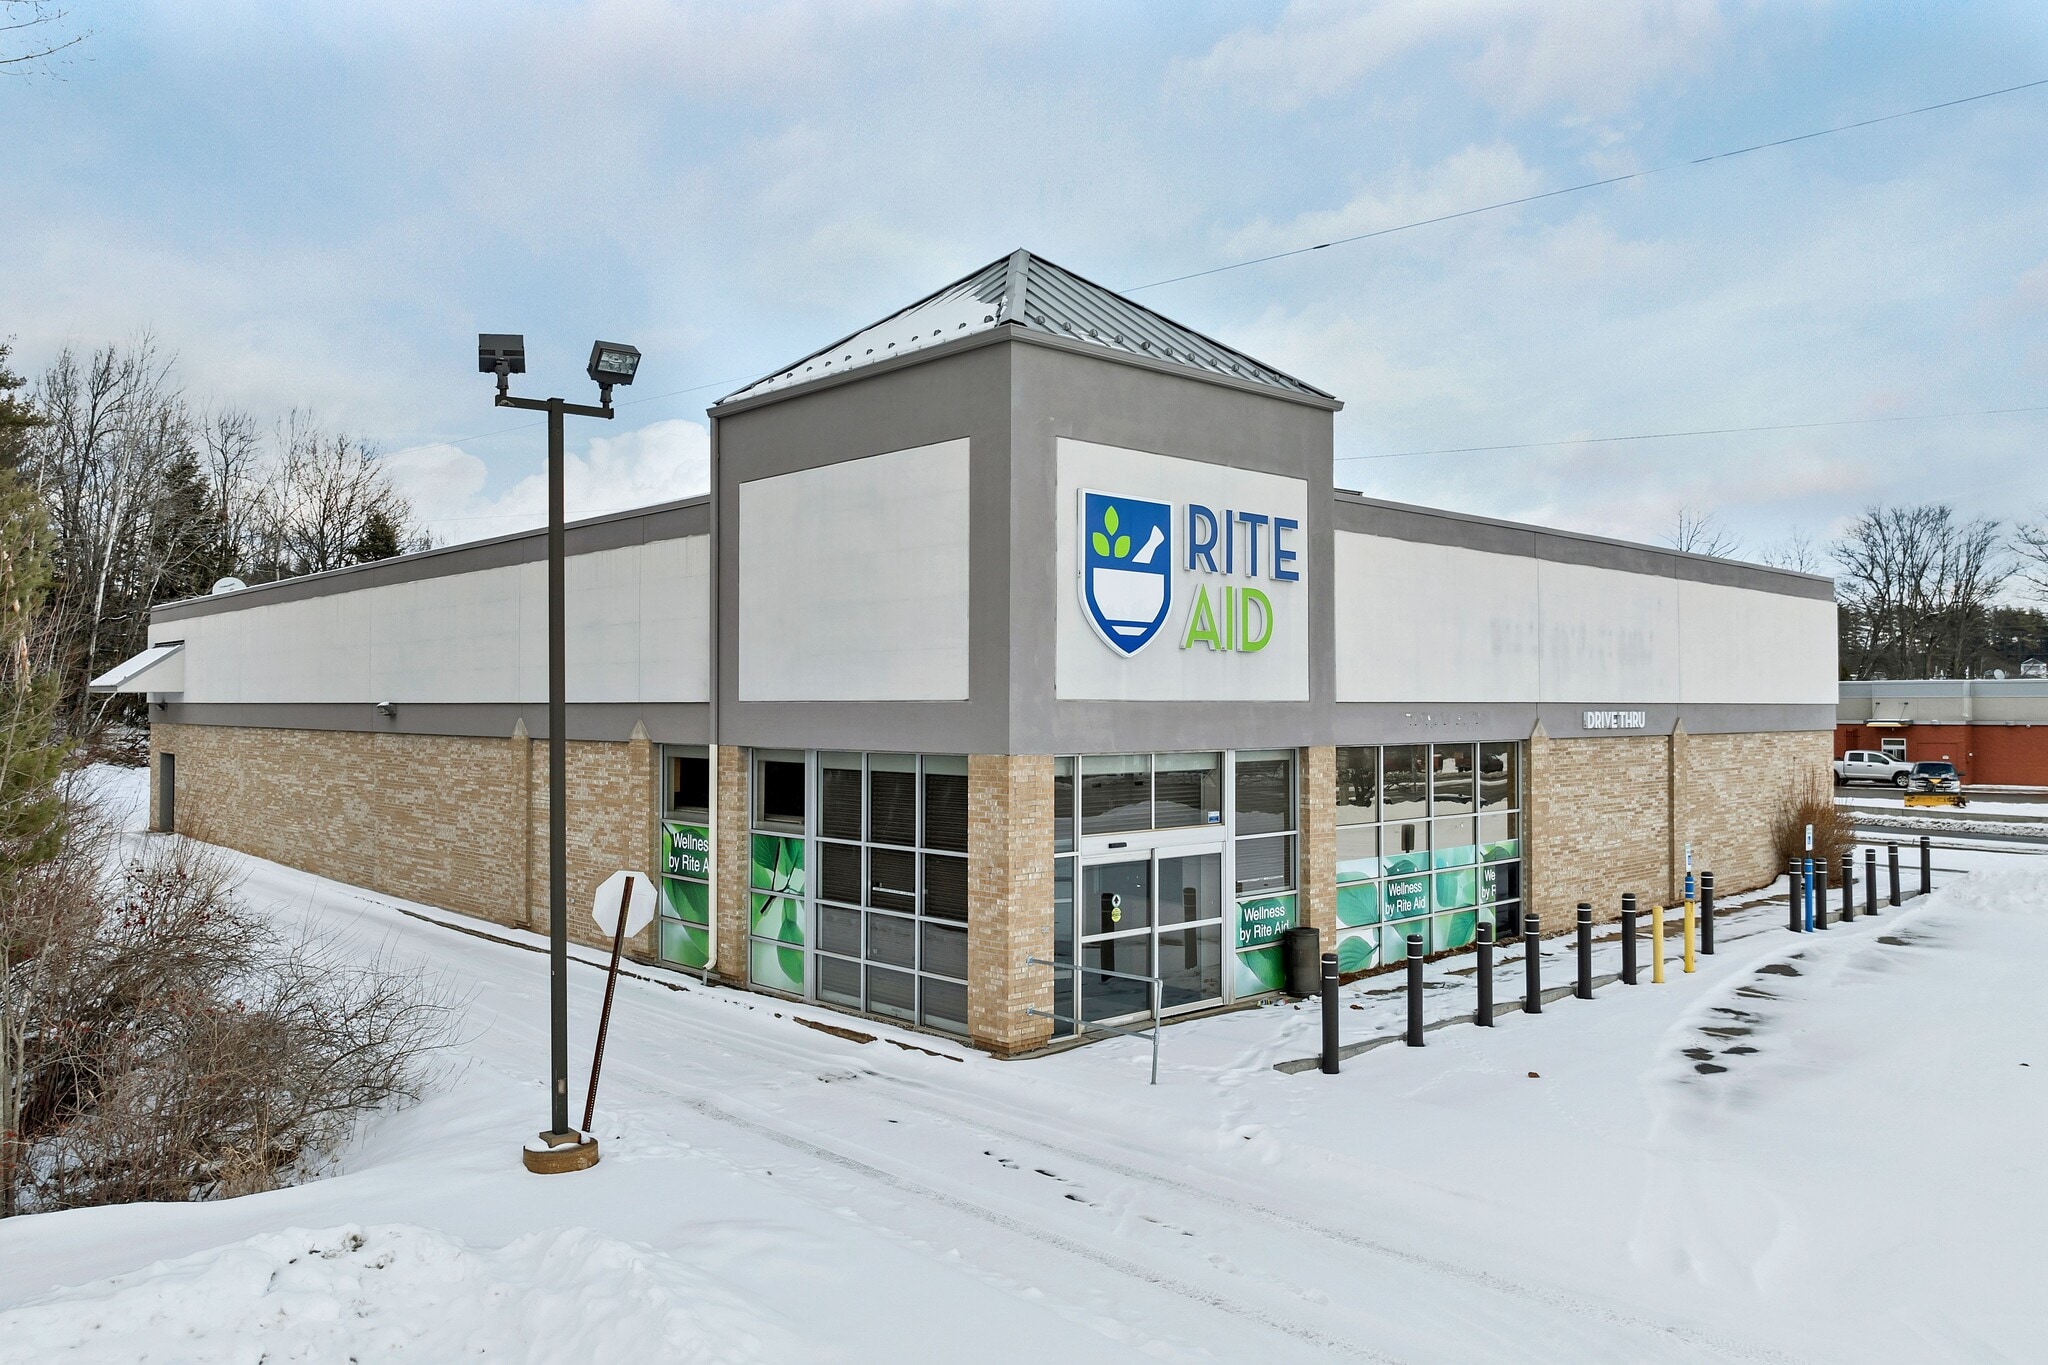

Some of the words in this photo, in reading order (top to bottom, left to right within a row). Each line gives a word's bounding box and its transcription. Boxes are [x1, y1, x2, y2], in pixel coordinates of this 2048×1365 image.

[1184, 503, 1300, 582] RITE
[1180, 584, 1274, 652] AID
[1584, 711, 1618, 729] DRIVE
[1619, 711, 1646, 729] THRU
[673, 832, 709, 852] Wellnes
[668, 852, 680, 872] by
[682, 854, 701, 872] Rite
[1388, 882, 1423, 896] Wellness
[1481, 886, 1490, 901] by
[1244, 906, 1286, 922] Wellness
[1385, 901, 1395, 918] by
[1396, 899, 1412, 912] Rite
[1413, 895, 1426, 910] Aid
[1239, 927, 1251, 943] by
[1253, 924, 1272, 938] Rite
